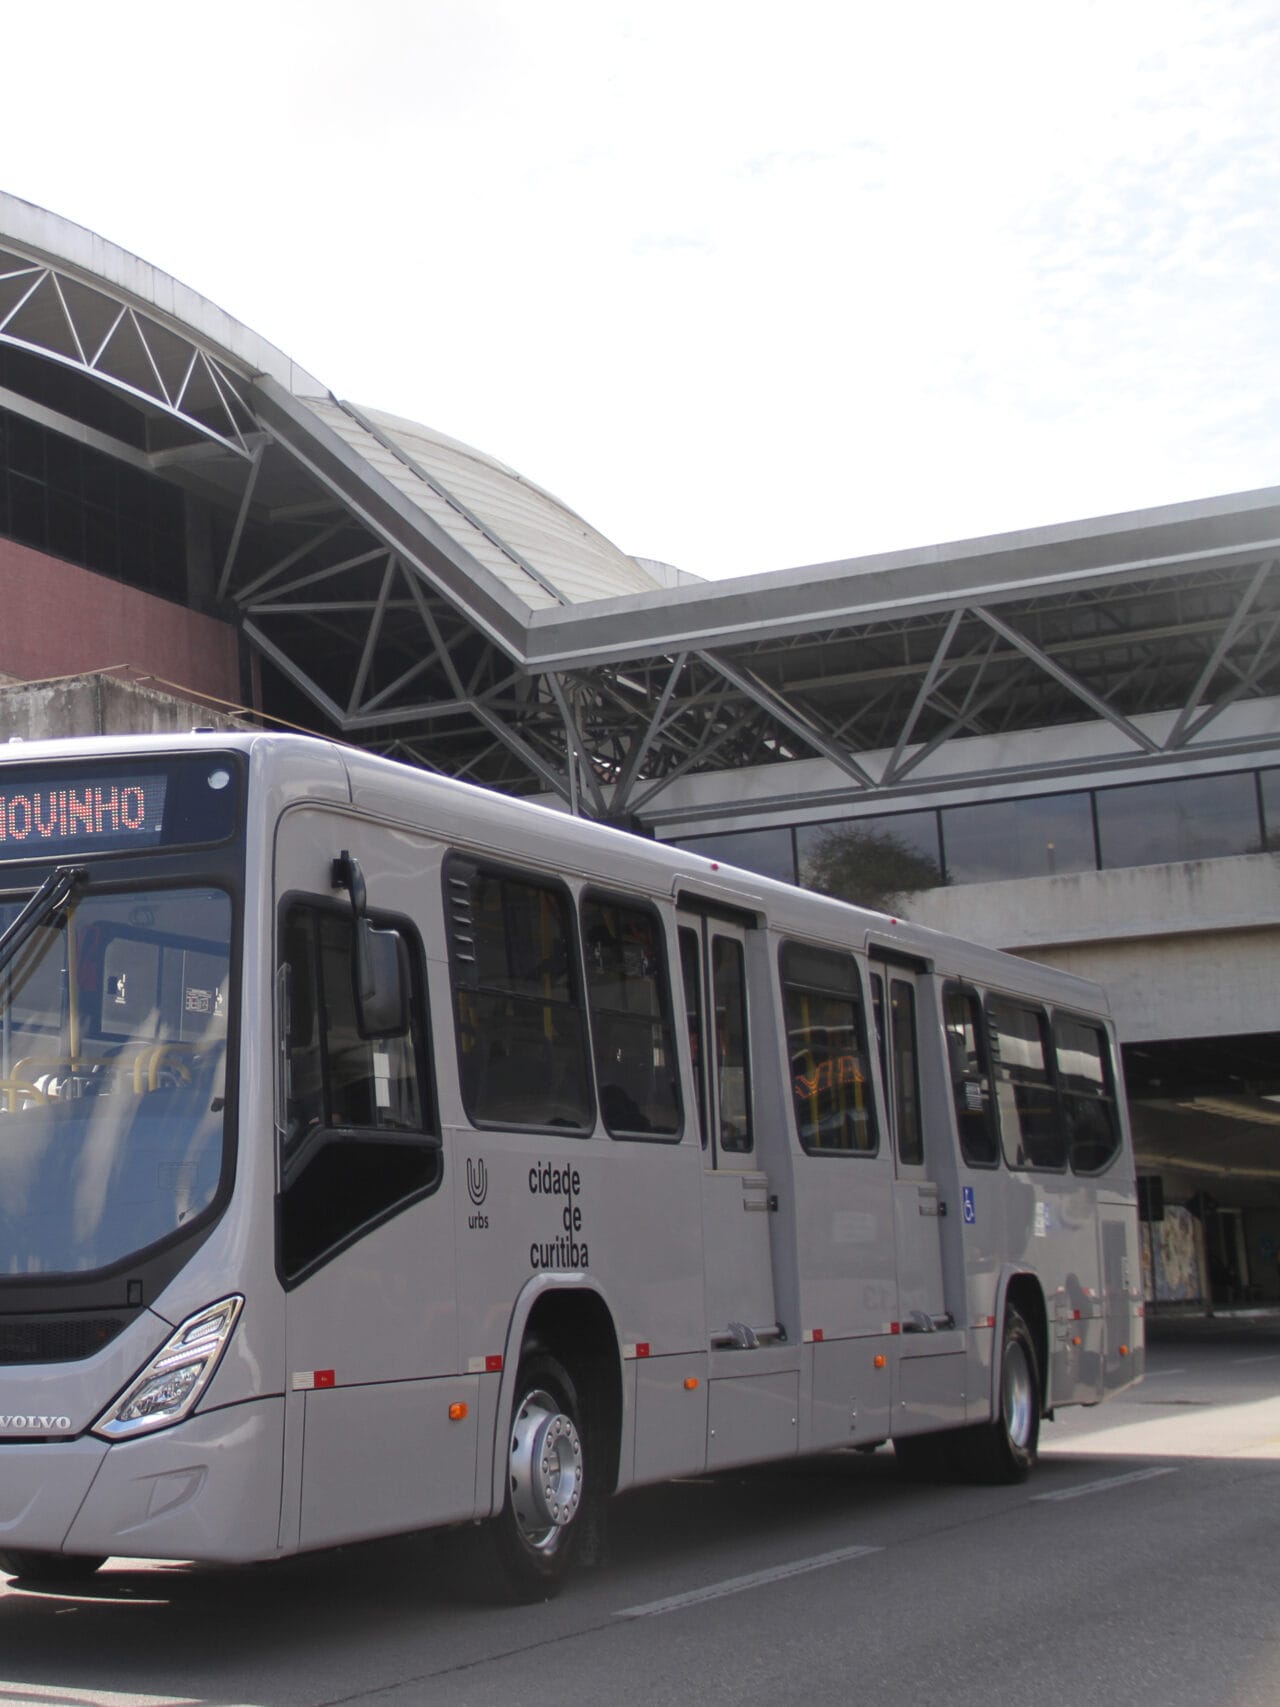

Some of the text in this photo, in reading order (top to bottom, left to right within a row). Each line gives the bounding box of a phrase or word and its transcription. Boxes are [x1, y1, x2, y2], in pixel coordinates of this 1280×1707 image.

[528, 1161, 581, 1195] cidade
[468, 1211, 489, 1229] urbs
[563, 1206, 582, 1231] de
[529, 1235, 589, 1269] curitiba
